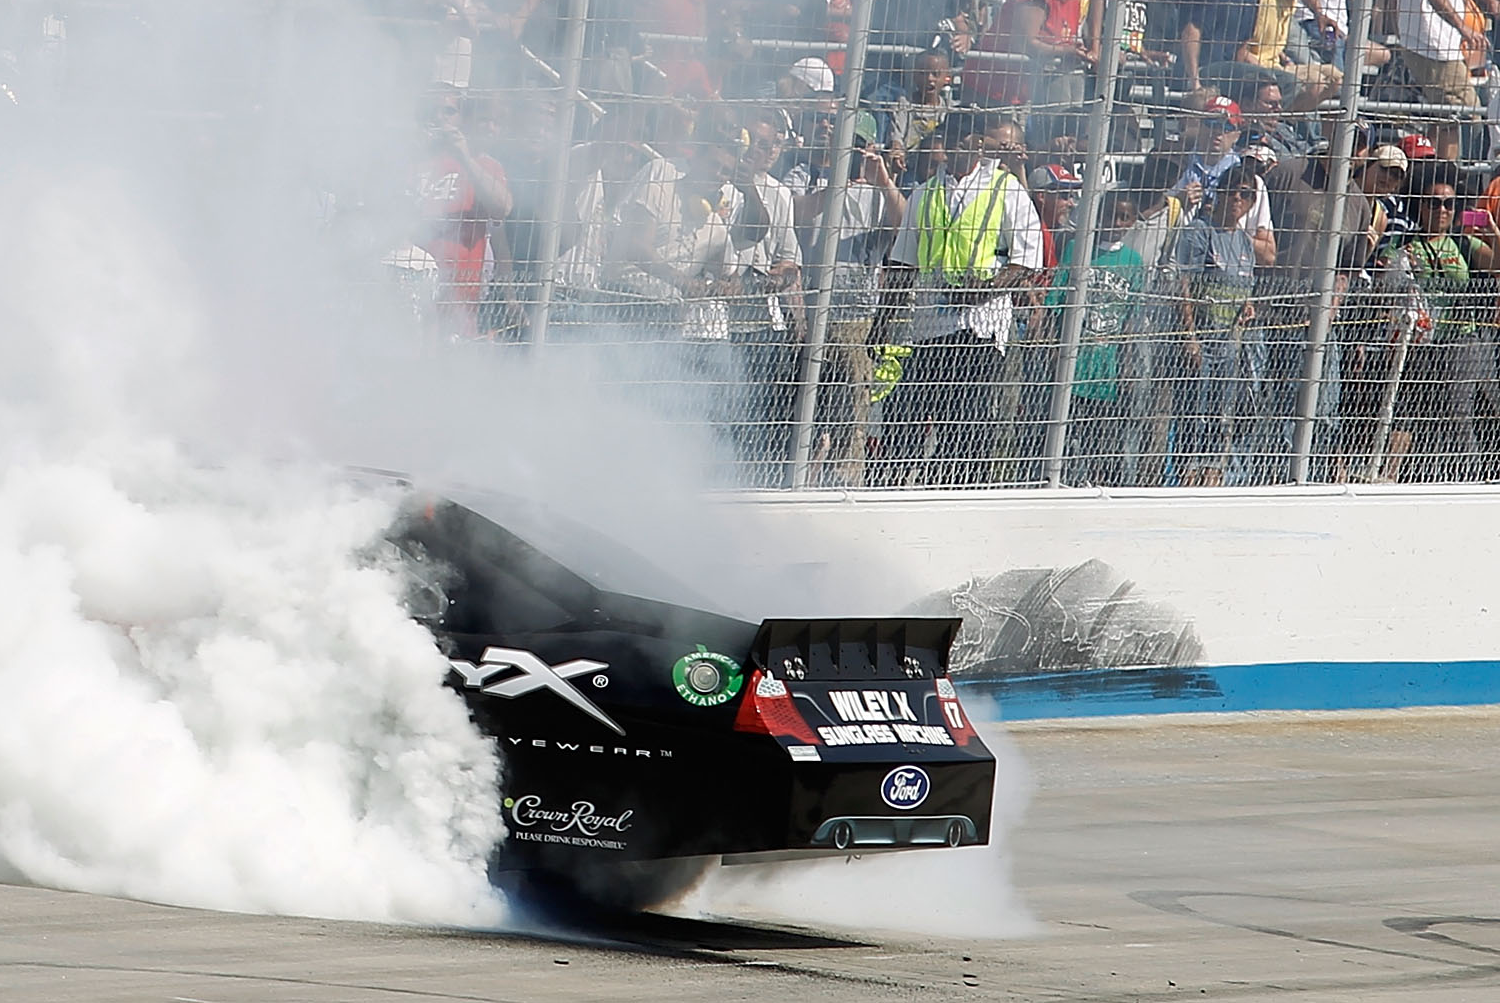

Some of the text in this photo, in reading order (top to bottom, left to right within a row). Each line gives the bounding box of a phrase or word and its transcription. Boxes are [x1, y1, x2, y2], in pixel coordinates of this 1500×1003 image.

[676, 683, 737, 707] ETHANOL
[828, 691, 918, 722] WILEY X
[943, 702, 964, 729] 17
[816, 724, 955, 746] SUNGLASS MACHINE
[889, 770, 922, 802] Ford
[511, 794, 634, 837] Crown Royal
[515, 831, 543, 843] PLEASE
[543, 834, 571, 846] DRINK
